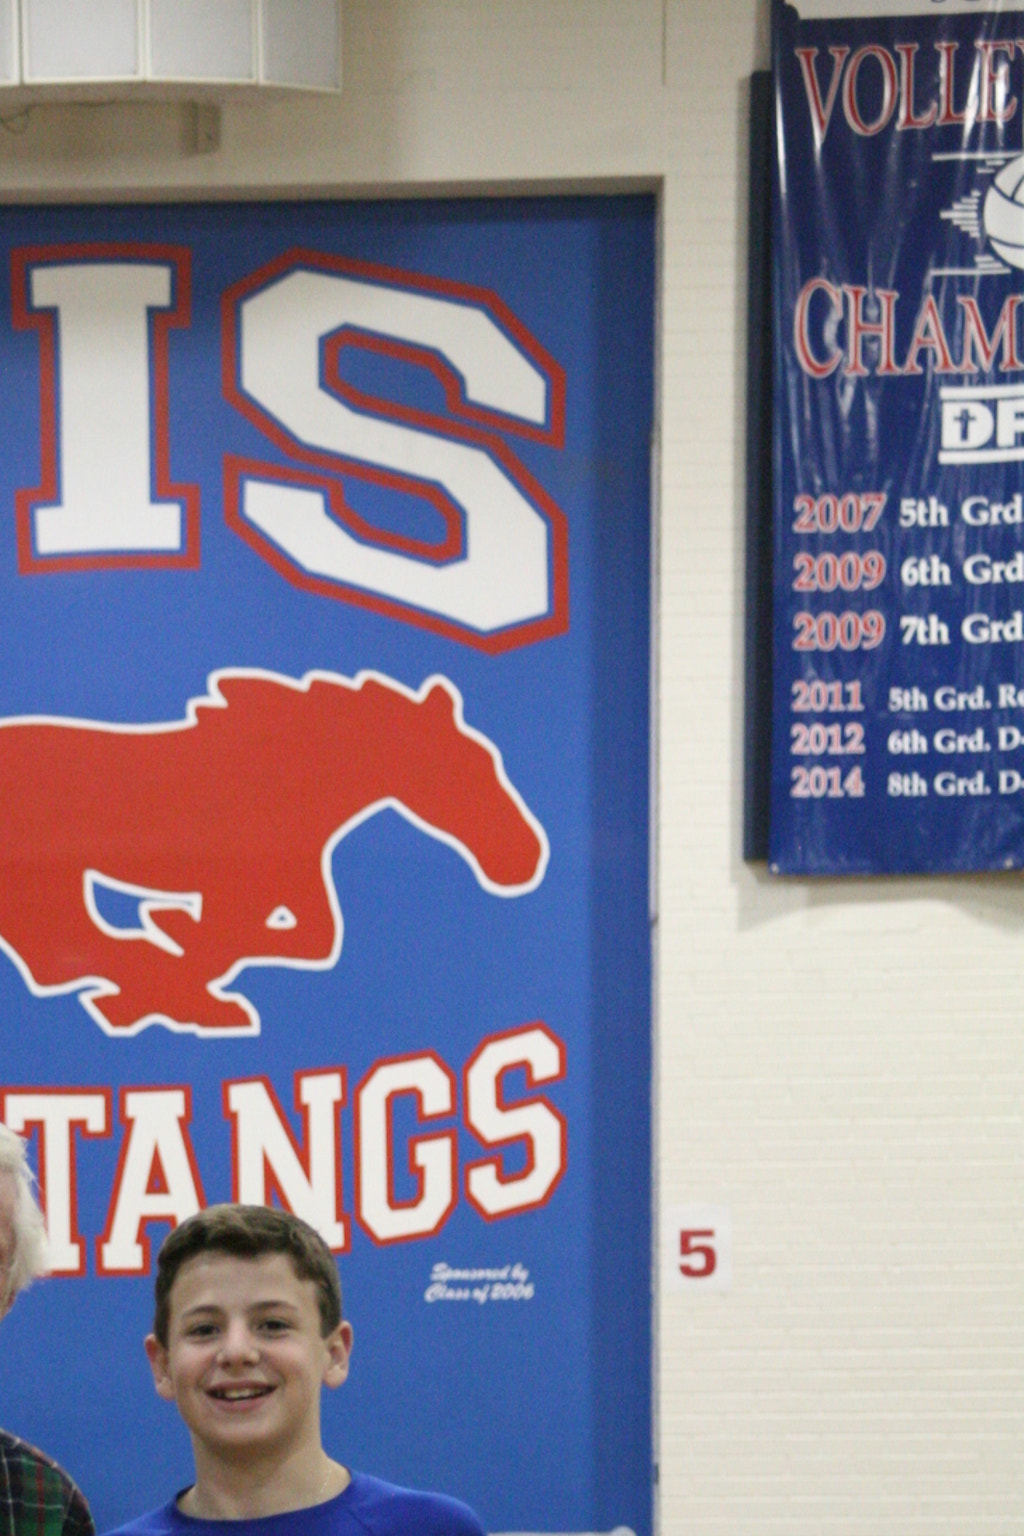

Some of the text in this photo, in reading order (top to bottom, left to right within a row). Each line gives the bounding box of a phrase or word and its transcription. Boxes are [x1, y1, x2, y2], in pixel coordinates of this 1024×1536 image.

[794, 39, 1024, 143] VOLLE
[793, 491, 887, 533] 2007
[899, 496, 950, 528] 5th
[793, 551, 886, 592] 2009
[901, 554, 952, 587] 6th
[793, 611, 886, 651] 2009
[899, 613, 951, 646] 7th
[791, 680, 865, 713] 2011
[888, 685, 929, 712] 5th
[933, 684, 991, 712] Grd.
[790, 723, 865, 756] 2012
[887, 728, 928, 755] 6th
[933, 727, 991, 754] Grd.
[790, 765, 865, 798] 2014
[887, 771, 928, 797] 8th
[933, 771, 991, 797] Grd.
[431, 1261, 529, 1283] Sponsored by
[679, 1230, 717, 1278] 5
[424, 1281, 470, 1303] Class
[472, 1284, 490, 1305] of
